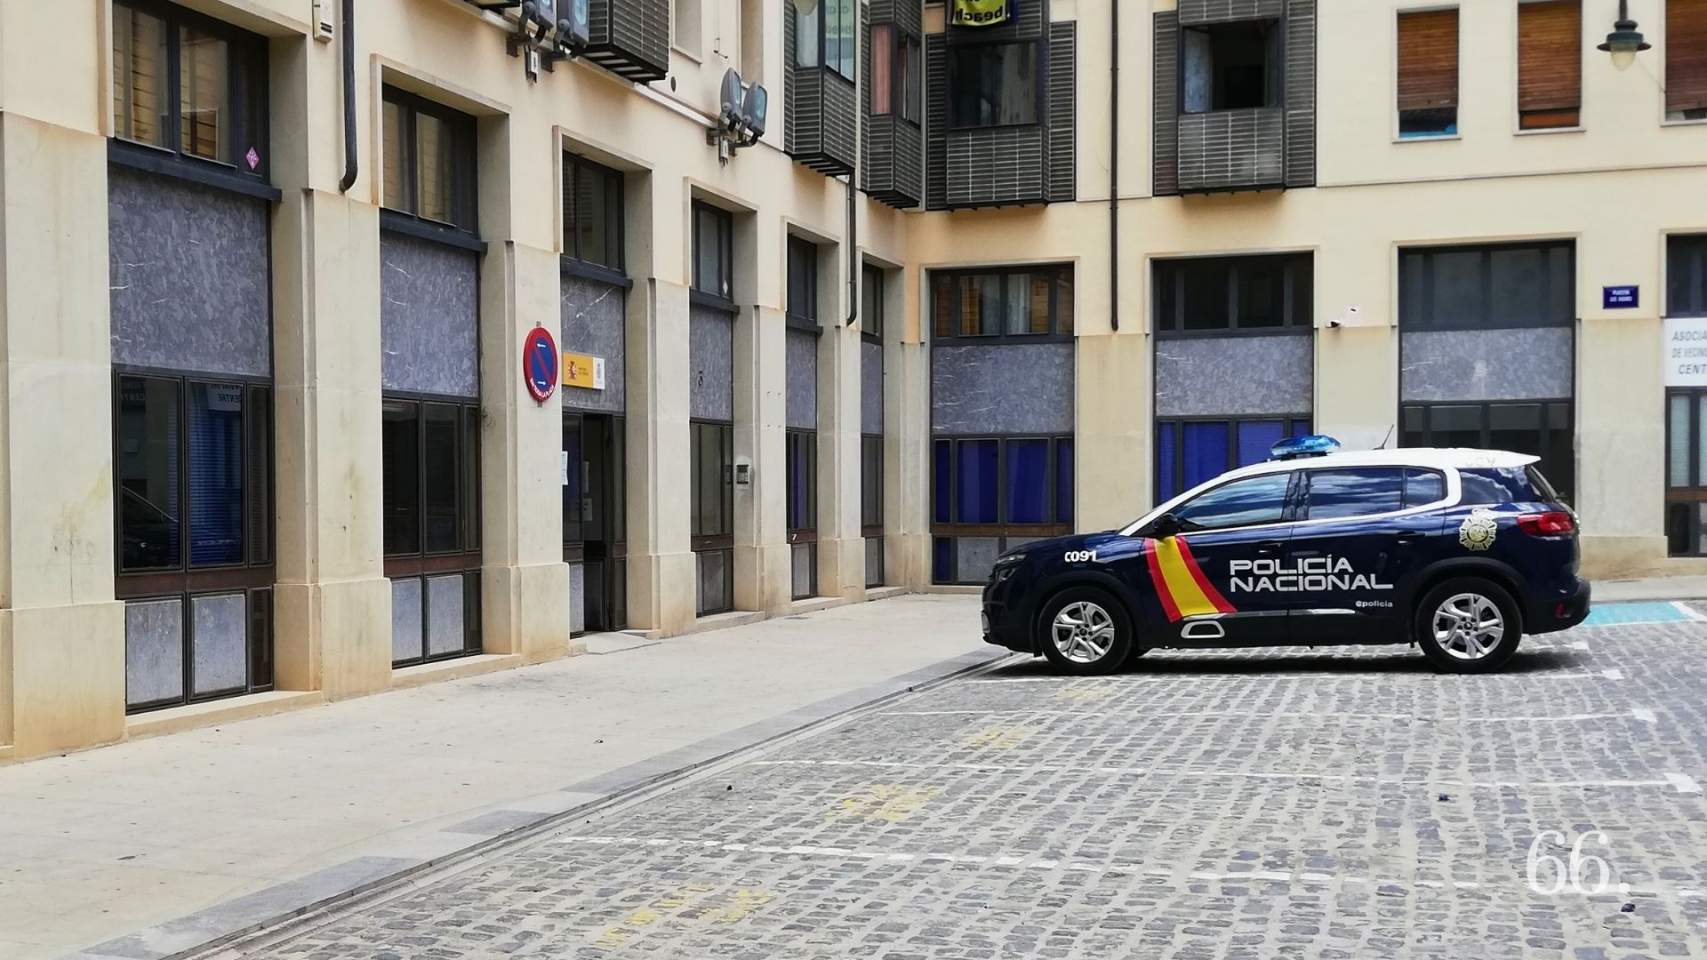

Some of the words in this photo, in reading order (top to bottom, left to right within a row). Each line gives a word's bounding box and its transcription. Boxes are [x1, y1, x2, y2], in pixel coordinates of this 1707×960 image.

[1229, 554, 1354, 576] POLICÍA
[1230, 573, 1394, 593] NACIONAL
[1355, 600, 1393, 608] @policia
